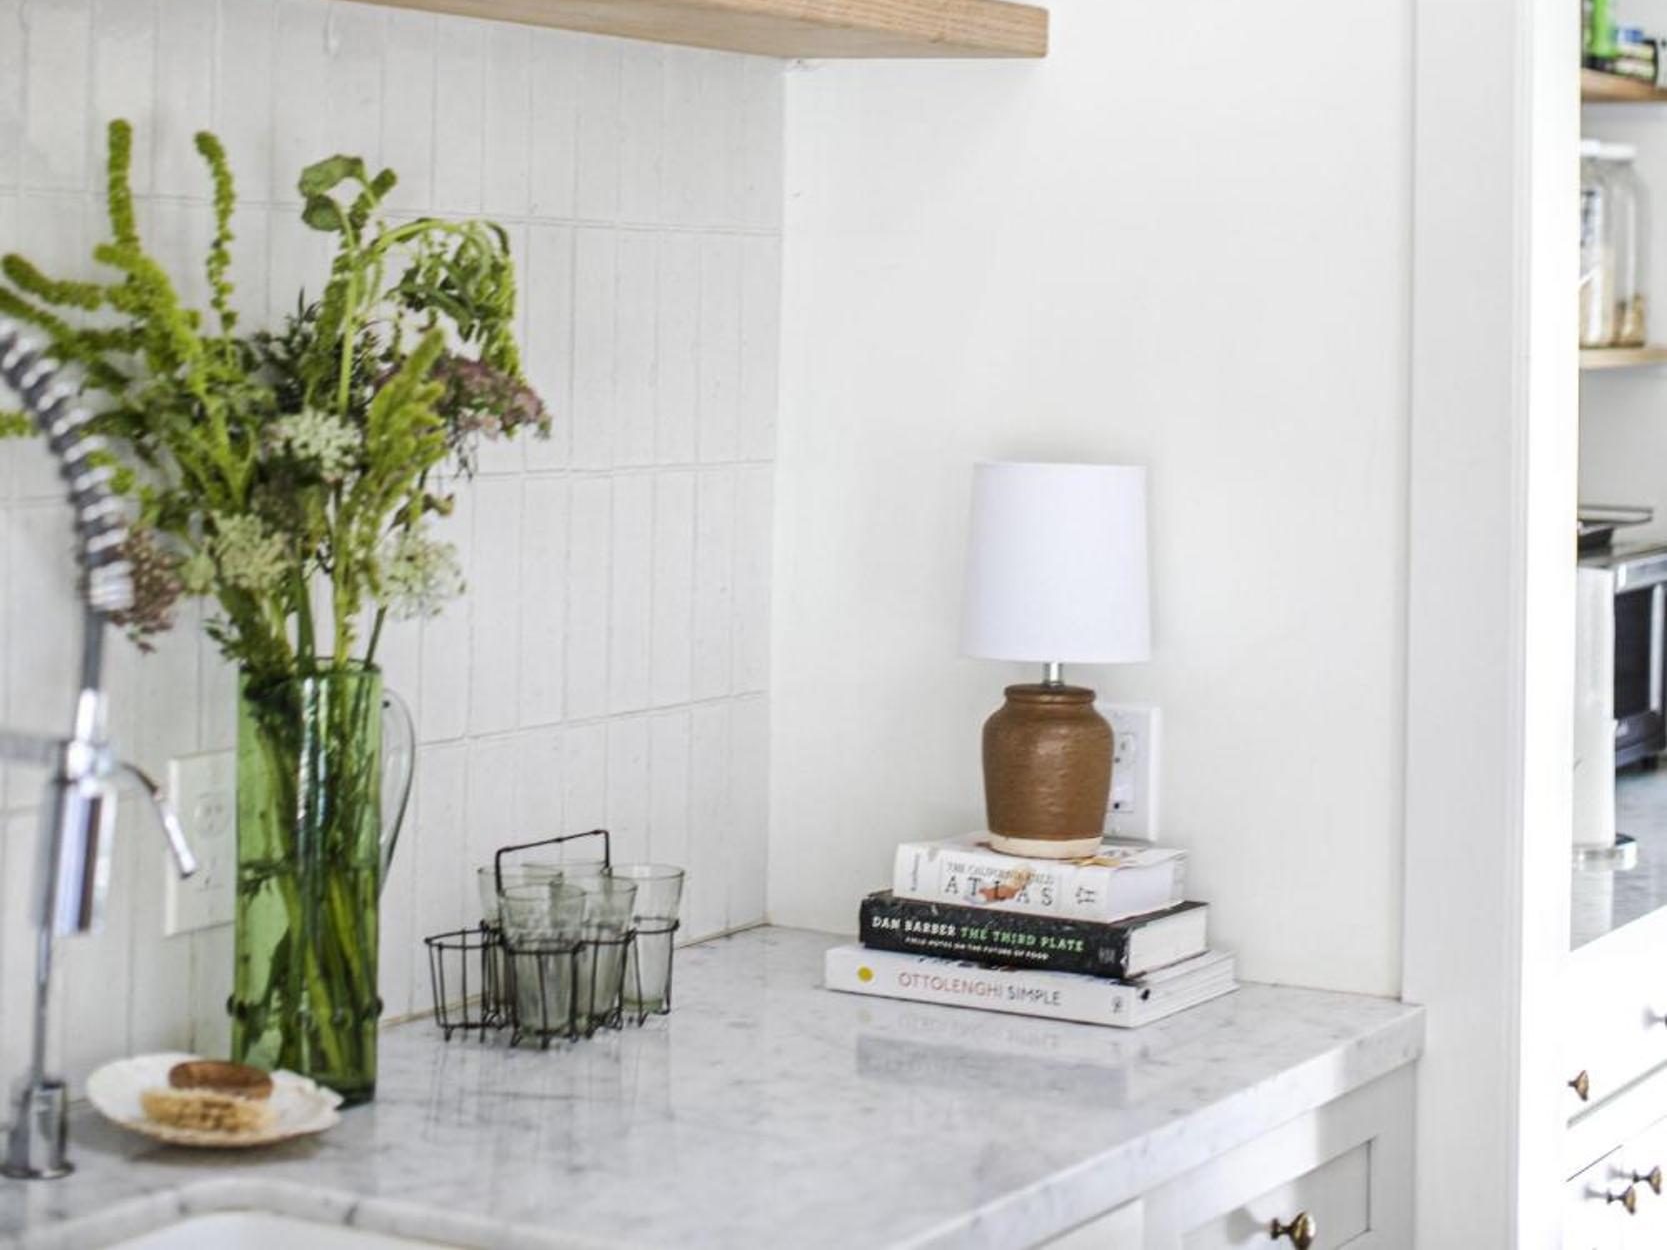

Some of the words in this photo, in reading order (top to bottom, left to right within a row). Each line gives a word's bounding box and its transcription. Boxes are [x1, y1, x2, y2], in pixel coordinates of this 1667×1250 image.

[944, 874, 1054, 906] ATLAS
[872, 915, 900, 929] DAN
[904, 918, 956, 937] BARBER
[960, 926, 988, 941] THE
[993, 930, 1036, 946] THIRD
[1041, 936, 1085, 953] PLATE
[899, 972, 1003, 998] OTTOLENGHI
[1007, 985, 1063, 1006] SIMPLE
